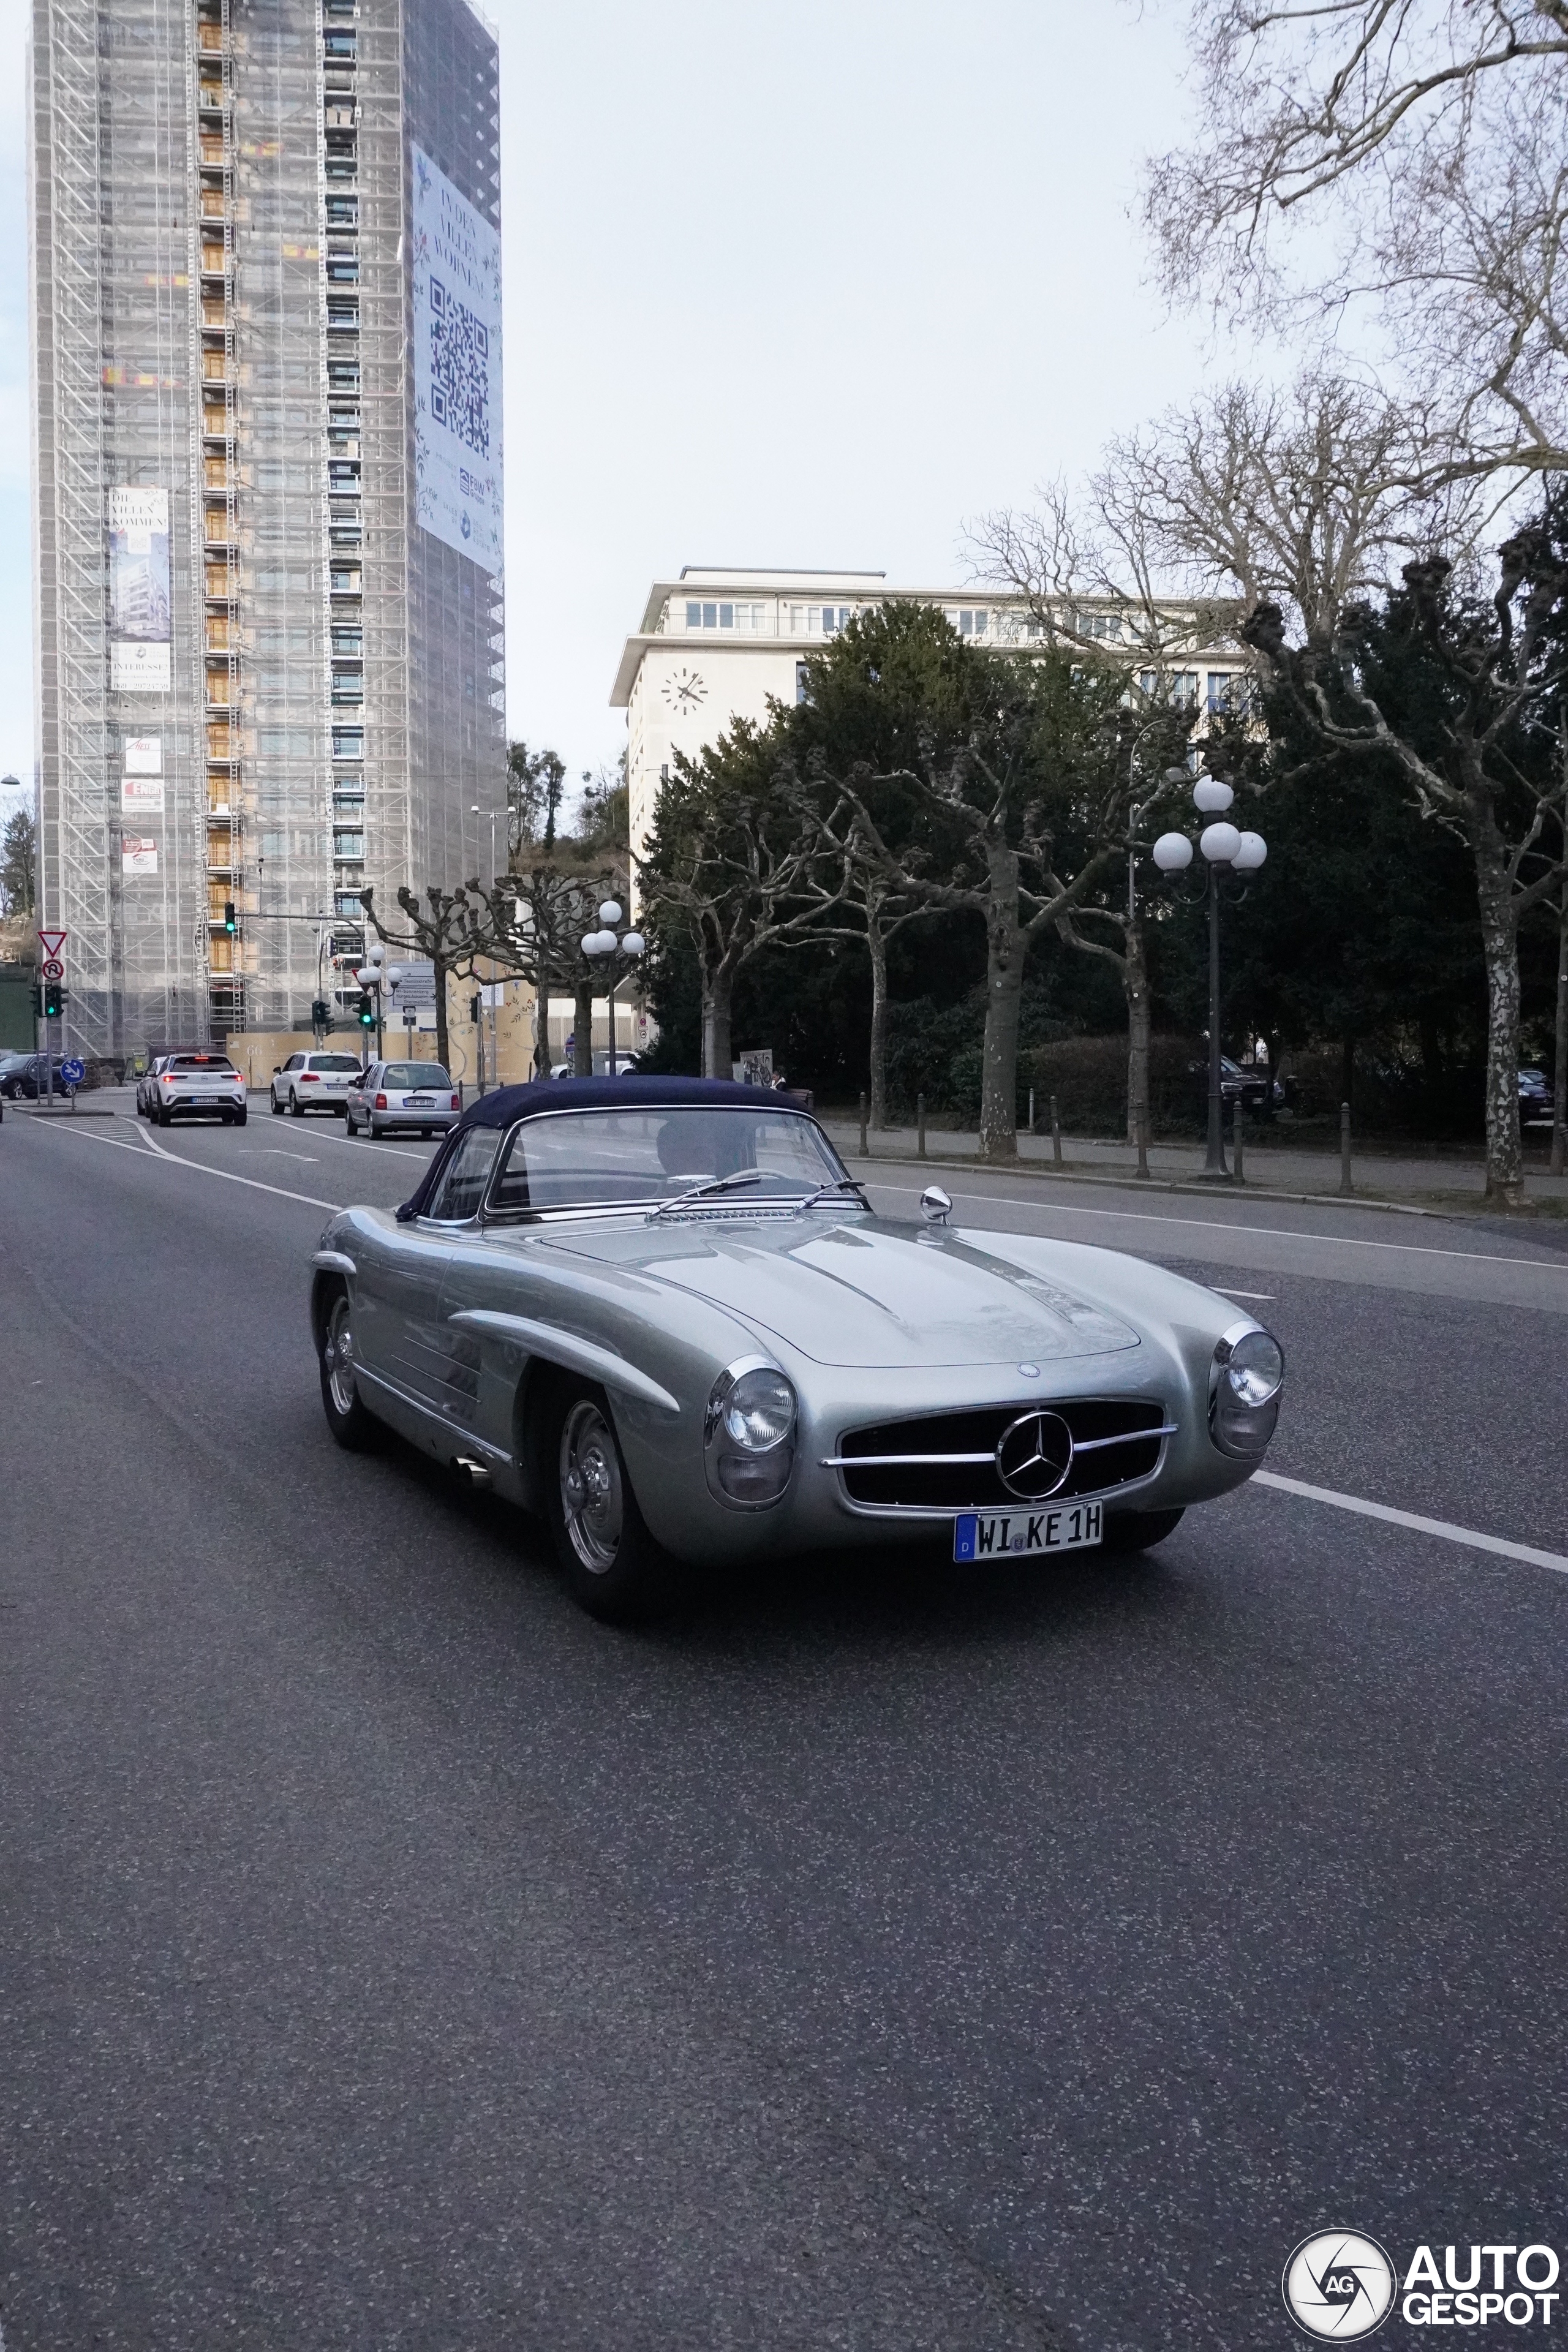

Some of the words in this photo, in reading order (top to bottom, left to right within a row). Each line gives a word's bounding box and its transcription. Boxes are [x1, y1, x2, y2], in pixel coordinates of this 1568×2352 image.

[440, 214, 478, 266] VILLEN
[434, 235, 484, 300] WOHNEN!
[470, 474, 485, 497] FBW
[113, 494, 132, 502] DIE
[113, 518, 167, 527] KOMMEN!
[135, 741, 151, 751] HESS
[134, 783, 161, 795] ENGEL
[246, 1044, 262, 1057] 66
[962, 1542, 969, 1552] D
[978, 1518, 1011, 1553] WI
[1027, 1512, 1062, 1548] KE
[1068, 1505, 1101, 1543] 1H
